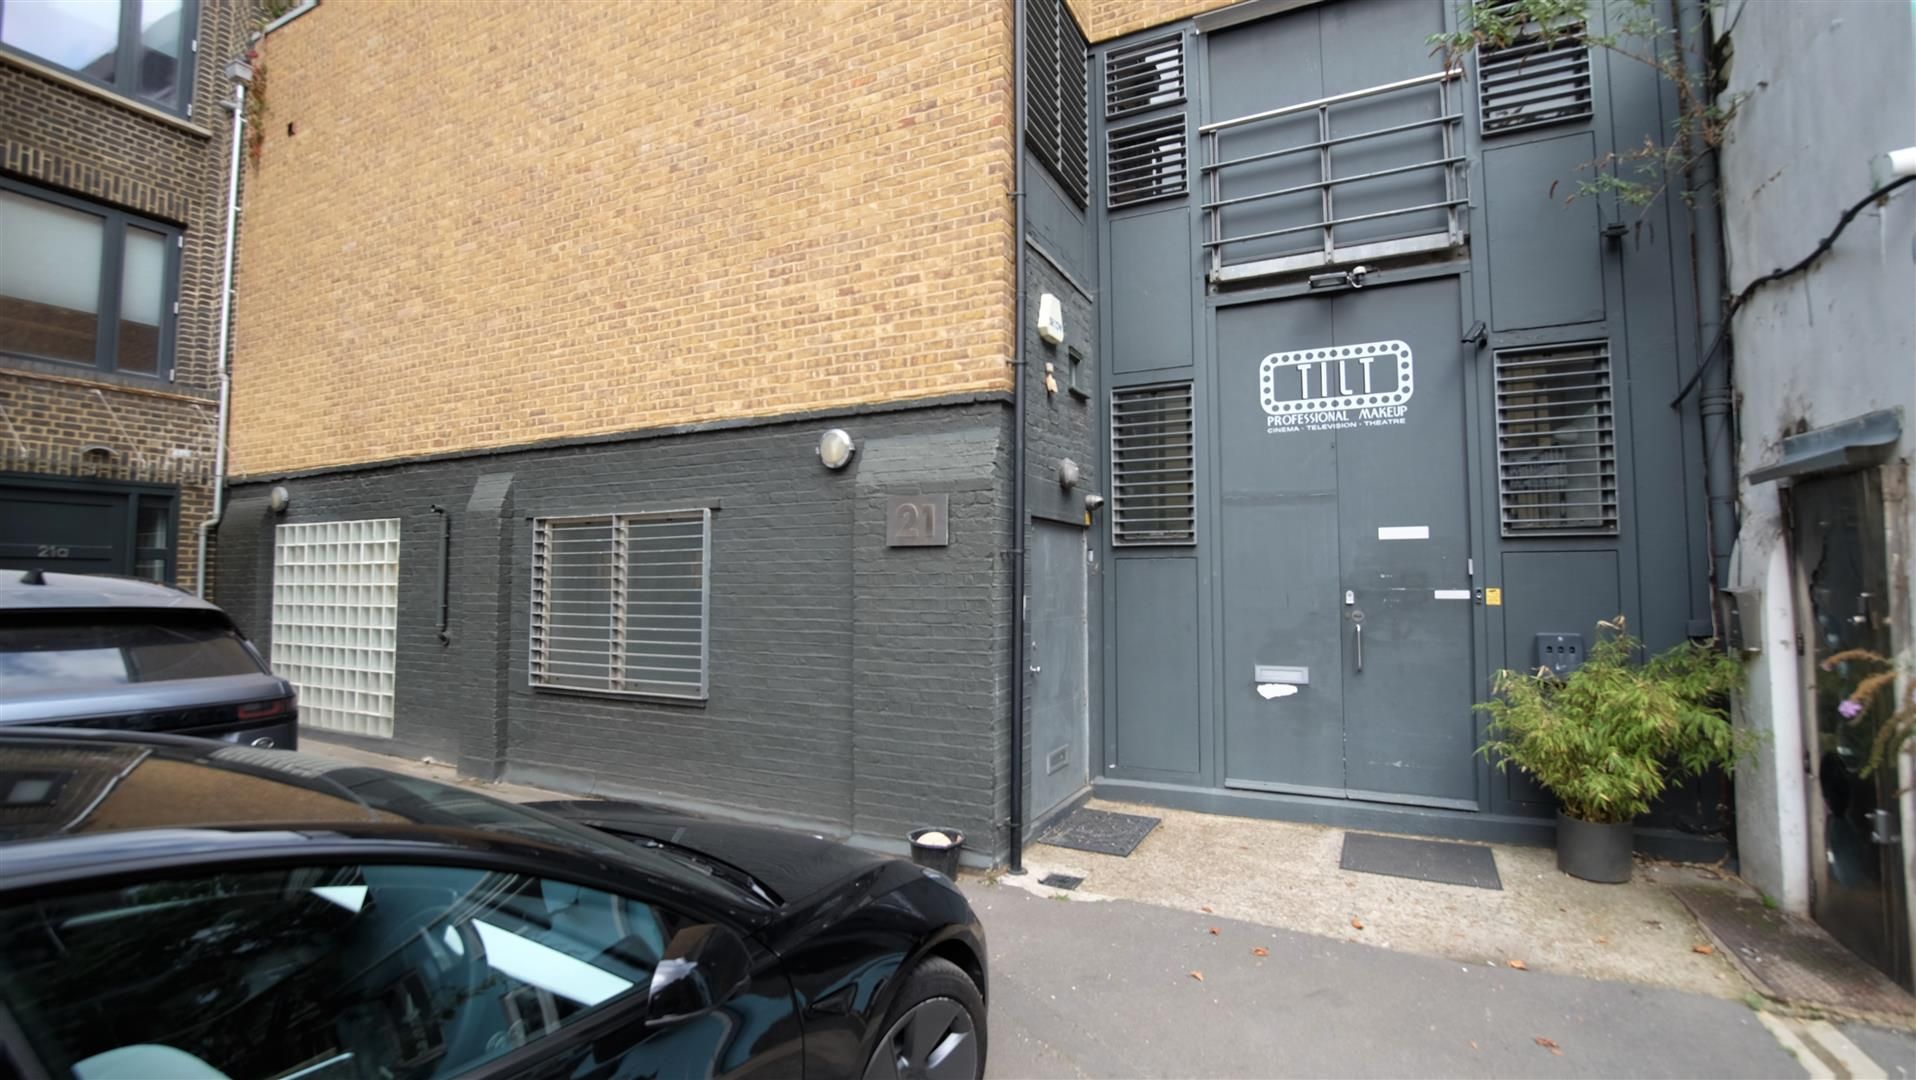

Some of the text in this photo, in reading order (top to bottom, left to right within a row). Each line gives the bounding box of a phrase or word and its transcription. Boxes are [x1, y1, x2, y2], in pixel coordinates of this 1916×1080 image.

[1296, 357, 1374, 399] TILT
[1267, 405, 1408, 427] PROFESSIONAL MAKEUP
[1267, 418, 1406, 434] CINEMA TELEVISION THEATRE
[895, 503, 936, 538] 21
[37, 545, 70, 558] 21a
